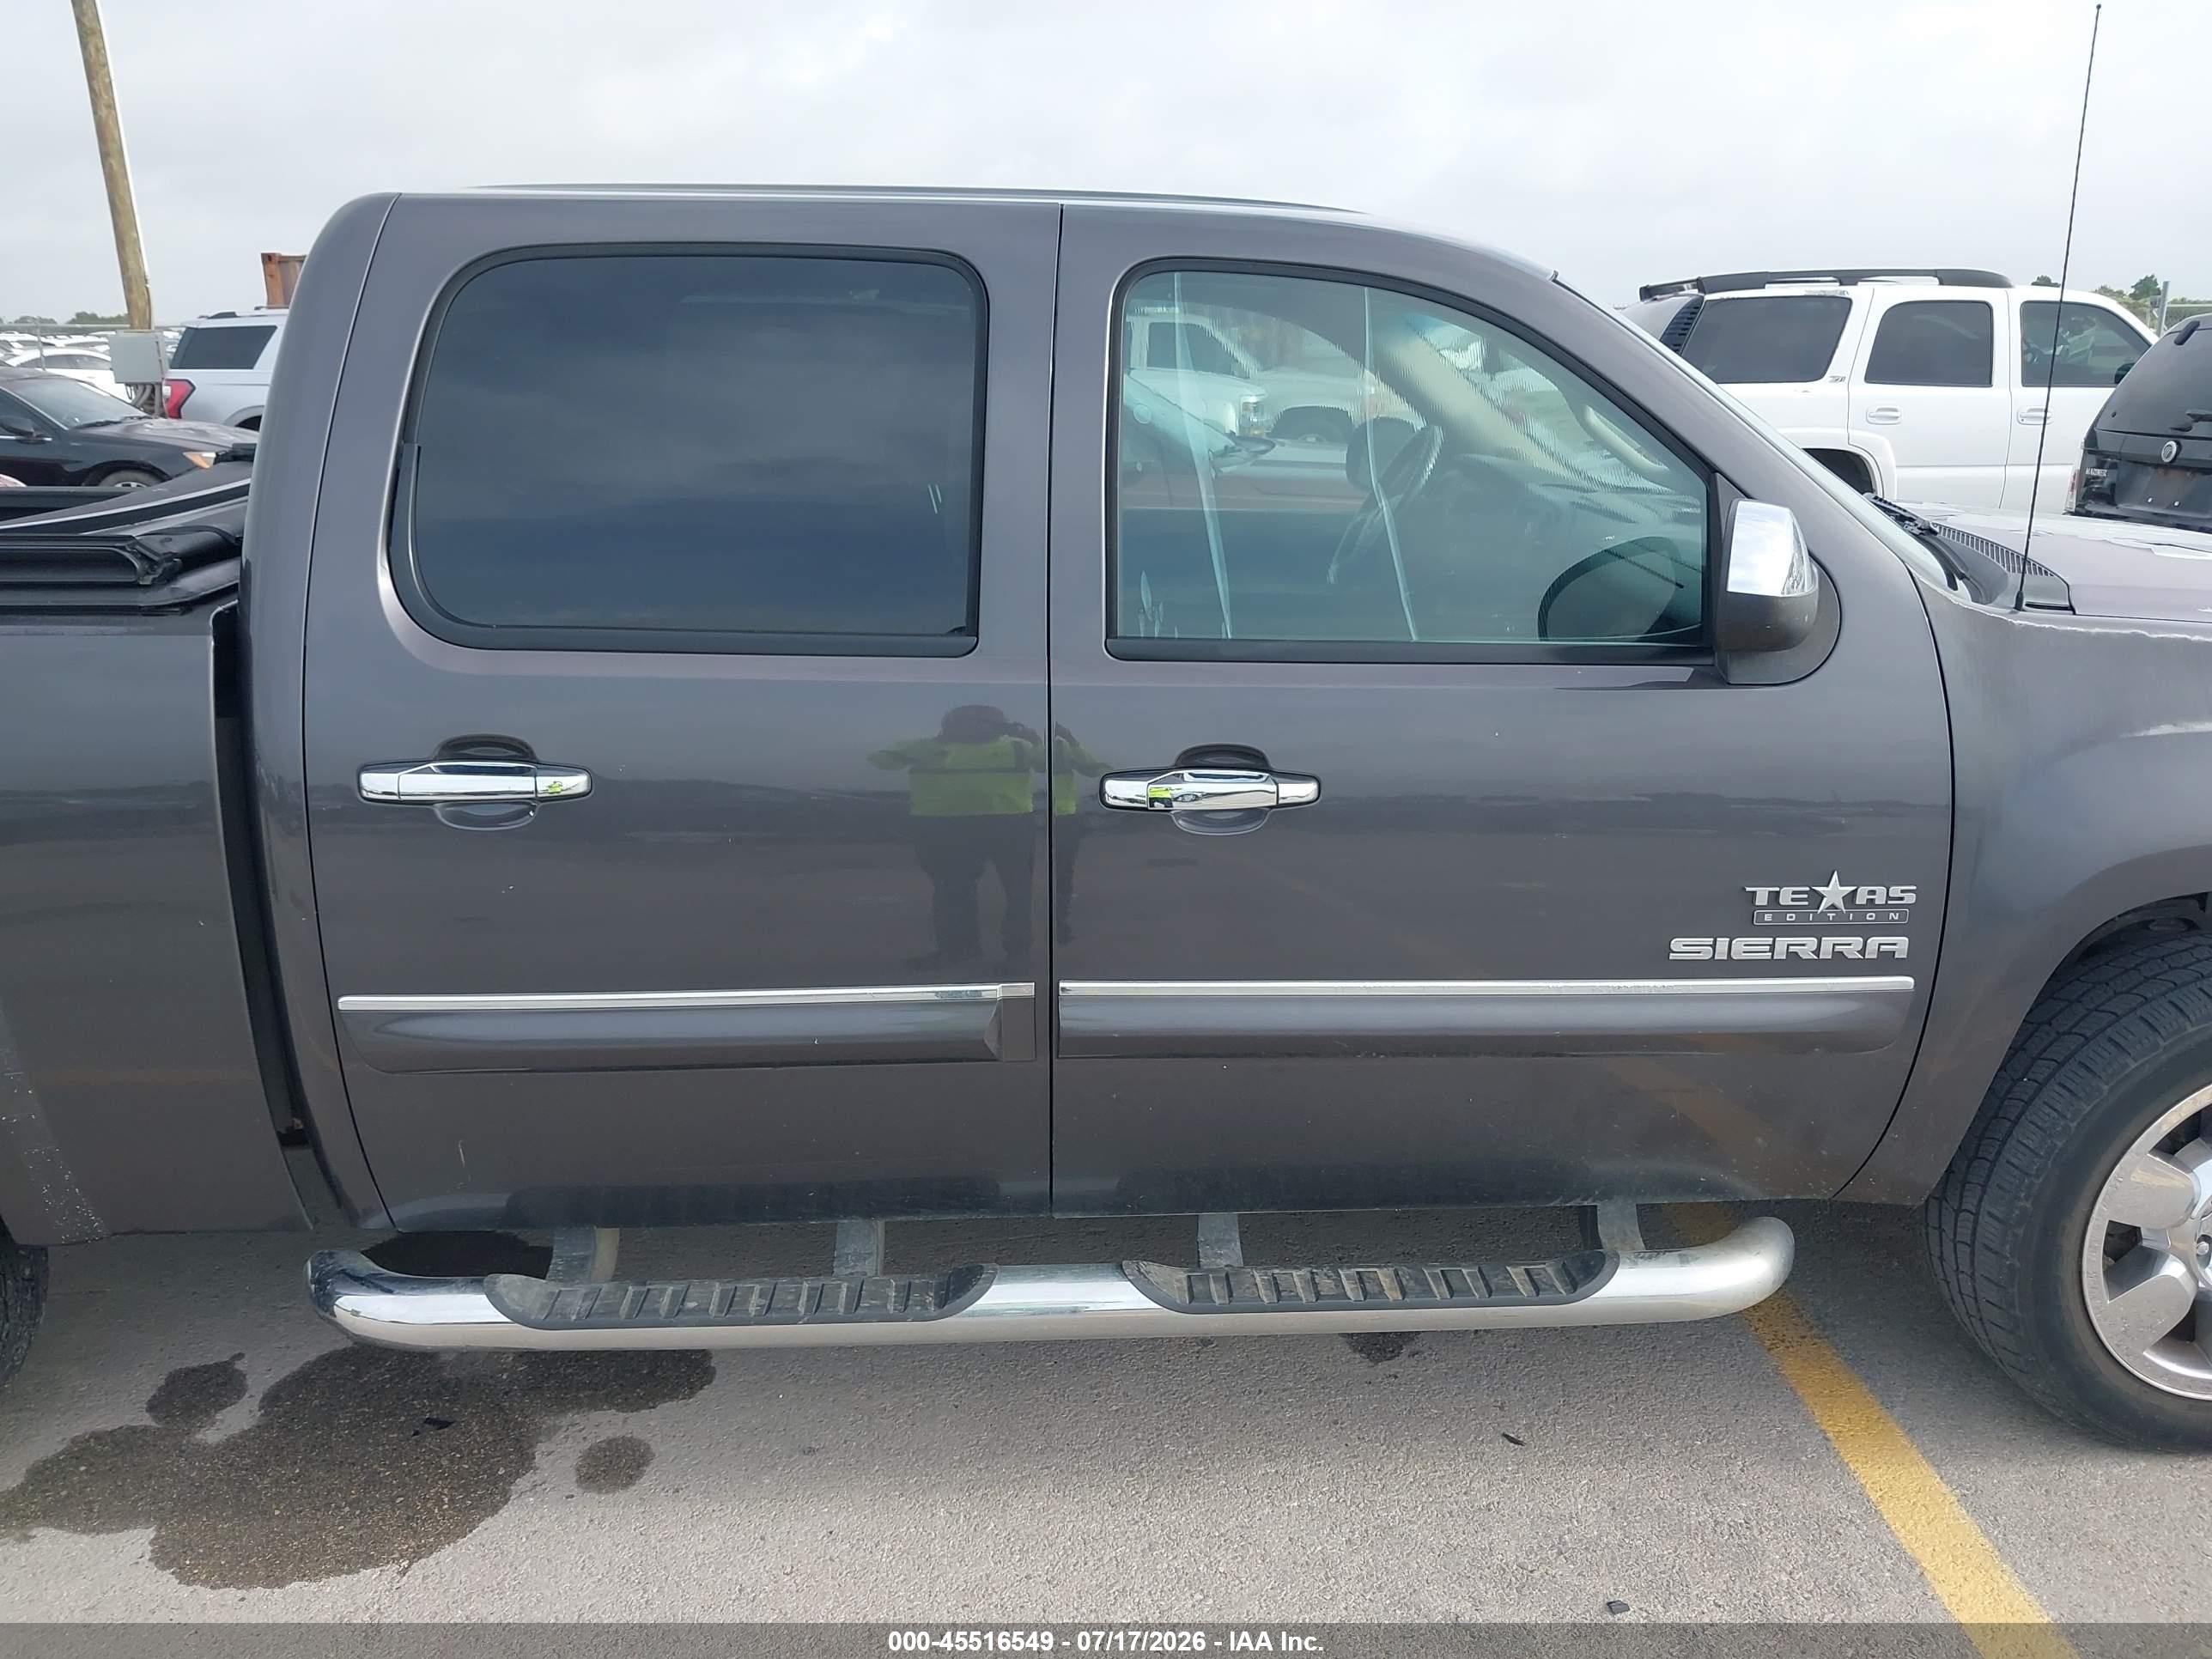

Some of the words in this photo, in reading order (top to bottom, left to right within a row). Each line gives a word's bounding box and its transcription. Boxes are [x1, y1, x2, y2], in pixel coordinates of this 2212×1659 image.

[1744, 870, 1917, 914] TEXAS
[1764, 912, 1899, 922] EDITION
[1669, 936, 1910, 960] SIERRA
